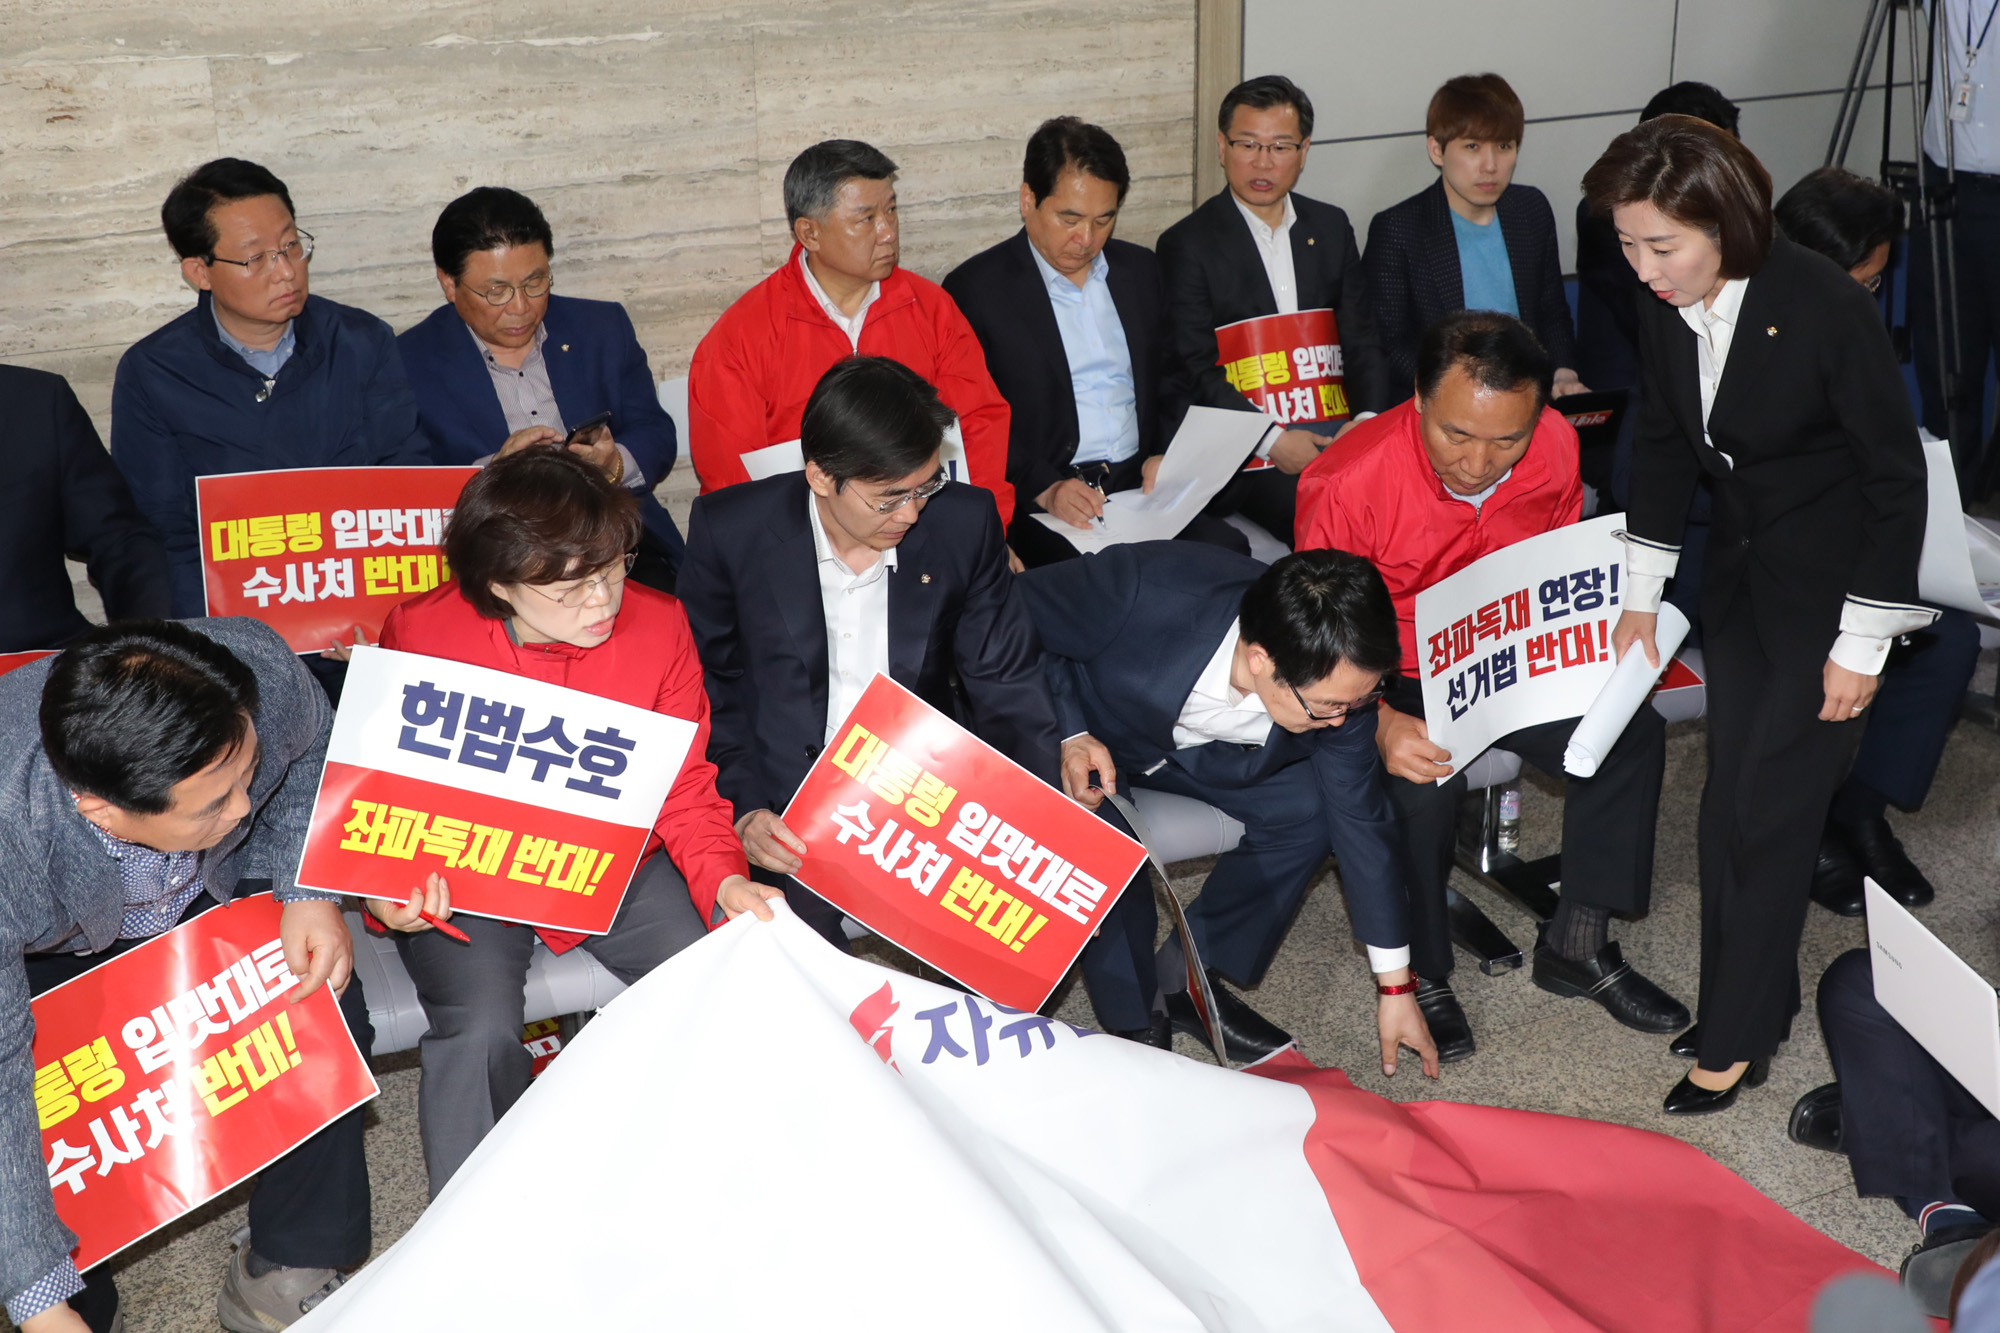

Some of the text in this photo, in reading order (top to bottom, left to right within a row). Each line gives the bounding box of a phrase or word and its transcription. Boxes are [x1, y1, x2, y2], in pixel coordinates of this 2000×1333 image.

[1248, 387, 1316, 424] 사처
[210, 508, 455, 561] 대통령 입맛대
[242, 558, 355, 607] 수사처
[1428, 563, 1619, 678] 좌파독재 연장!
[1447, 619, 1608, 722] 선거법 반대!
[397, 680, 636, 800] 헌법수호
[340, 799, 615, 896] 좌파독재 반대!
[831, 723, 1108, 925] 대통령 입맛대로
[830, 800, 1049, 953] 수사처 반대!
[914, 994, 1103, 1066] 자유
[34, 1035, 126, 1130] 통령
[48, 1010, 302, 1195] 수사처 반대!
